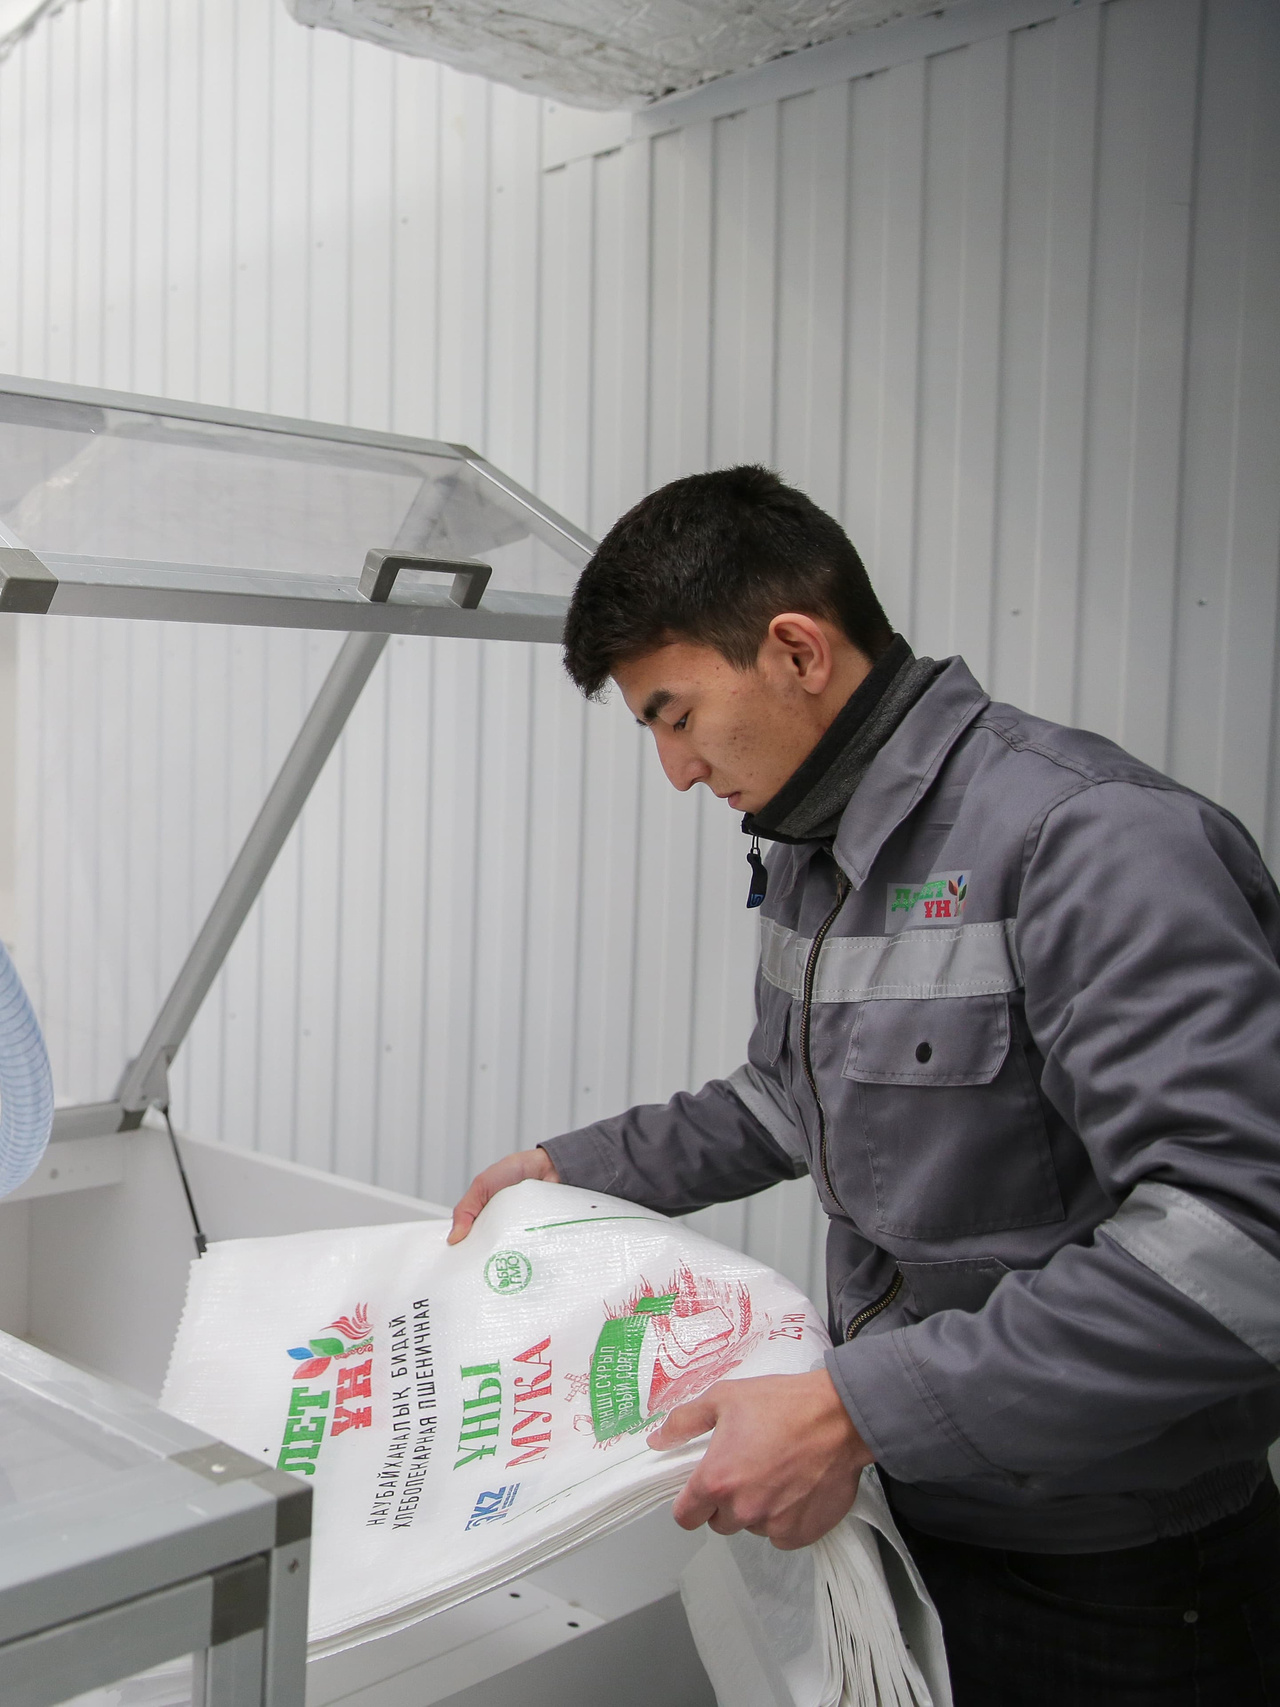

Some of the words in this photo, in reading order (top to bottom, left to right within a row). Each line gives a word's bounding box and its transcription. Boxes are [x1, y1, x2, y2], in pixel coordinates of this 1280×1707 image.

[496, 1258, 509, 1279] БЕЗ
[507, 1256, 522, 1284] ГМО
[388, 1314, 410, 1378] БИДАЙ
[412, 1298, 437, 1408] ПШЕНИЧНАЯ
[768, 1326, 804, 1340] 25
[504, 1334, 552, 1470] МУКА
[392, 1416, 438, 1530] ХЛЕБОПЕКАРНАЯ
